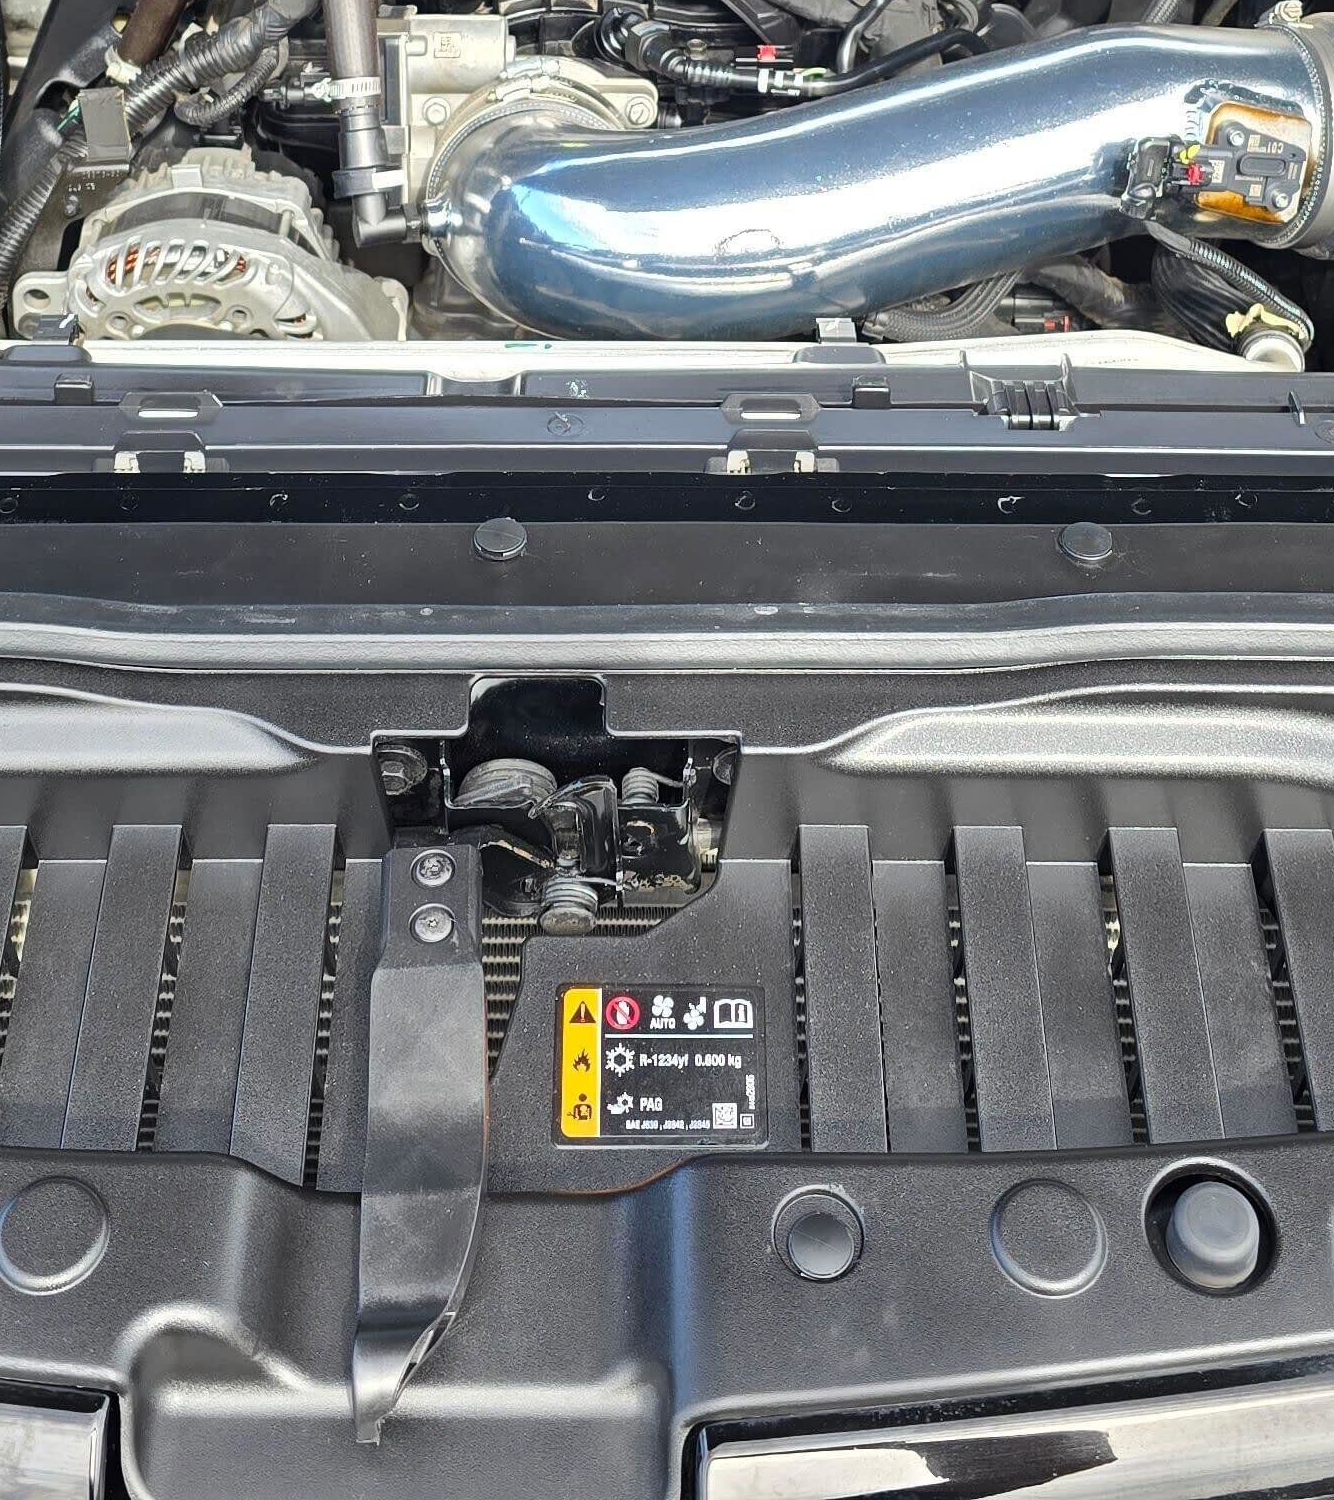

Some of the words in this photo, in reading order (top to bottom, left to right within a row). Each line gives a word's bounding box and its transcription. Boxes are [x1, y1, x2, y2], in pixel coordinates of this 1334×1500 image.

[649, 1018, 676, 1029] AUTO
[639, 1053, 689, 1069] R-1234yf
[727, 1053, 742, 1069] kg
[639, 1097, 663, 1112] PAG
